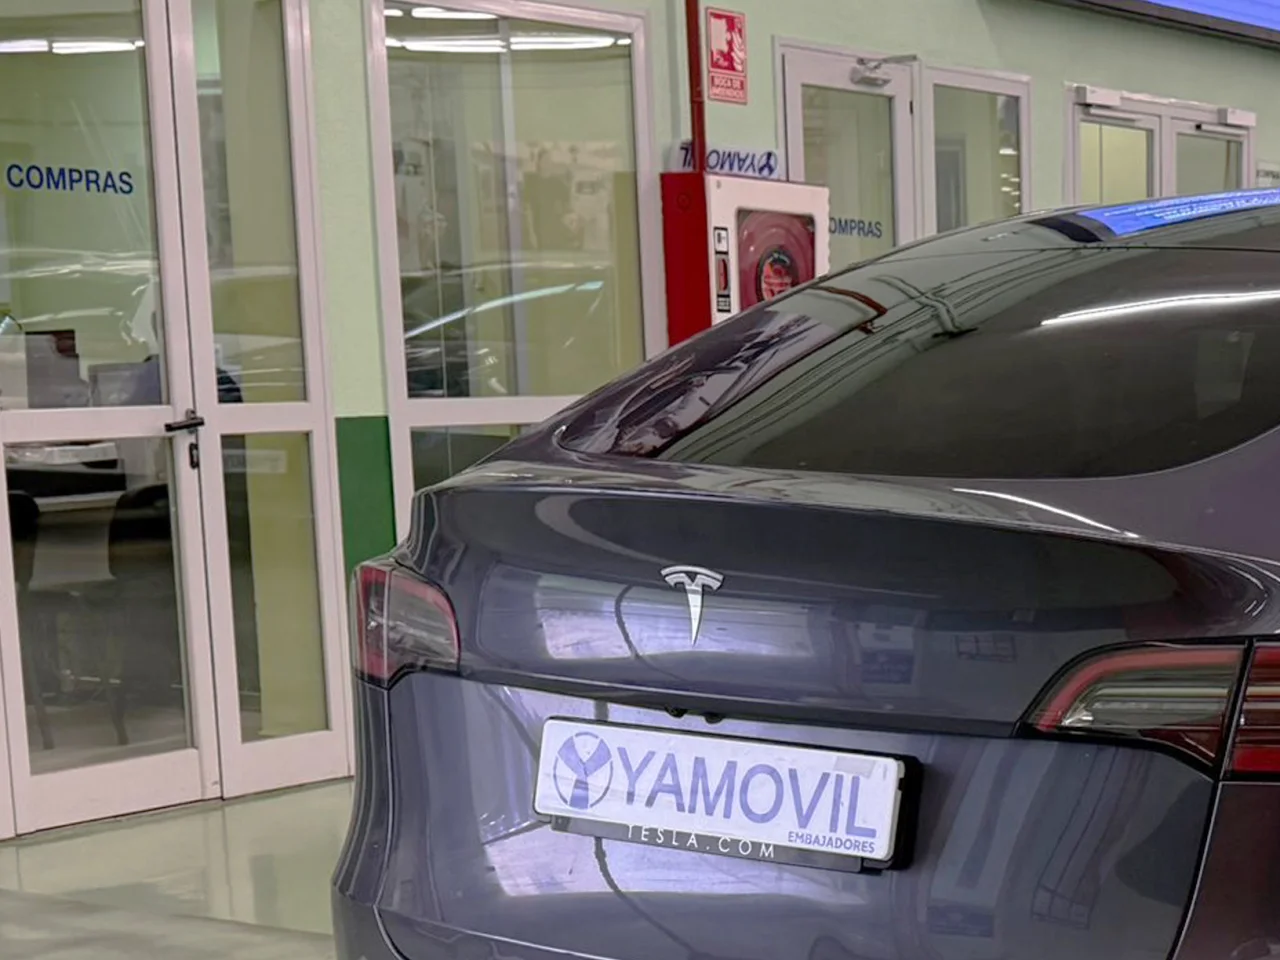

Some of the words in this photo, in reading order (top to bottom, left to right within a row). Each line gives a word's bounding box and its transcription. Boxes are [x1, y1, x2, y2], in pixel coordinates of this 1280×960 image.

[6, 164, 134, 195] COMPRAS
[828, 217, 882, 238] OMPRAS
[617, 745, 877, 839] YAMOVIL
[626, 823, 775, 859] TESLA.COM
[787, 830, 876, 854] EMBAJADORES
